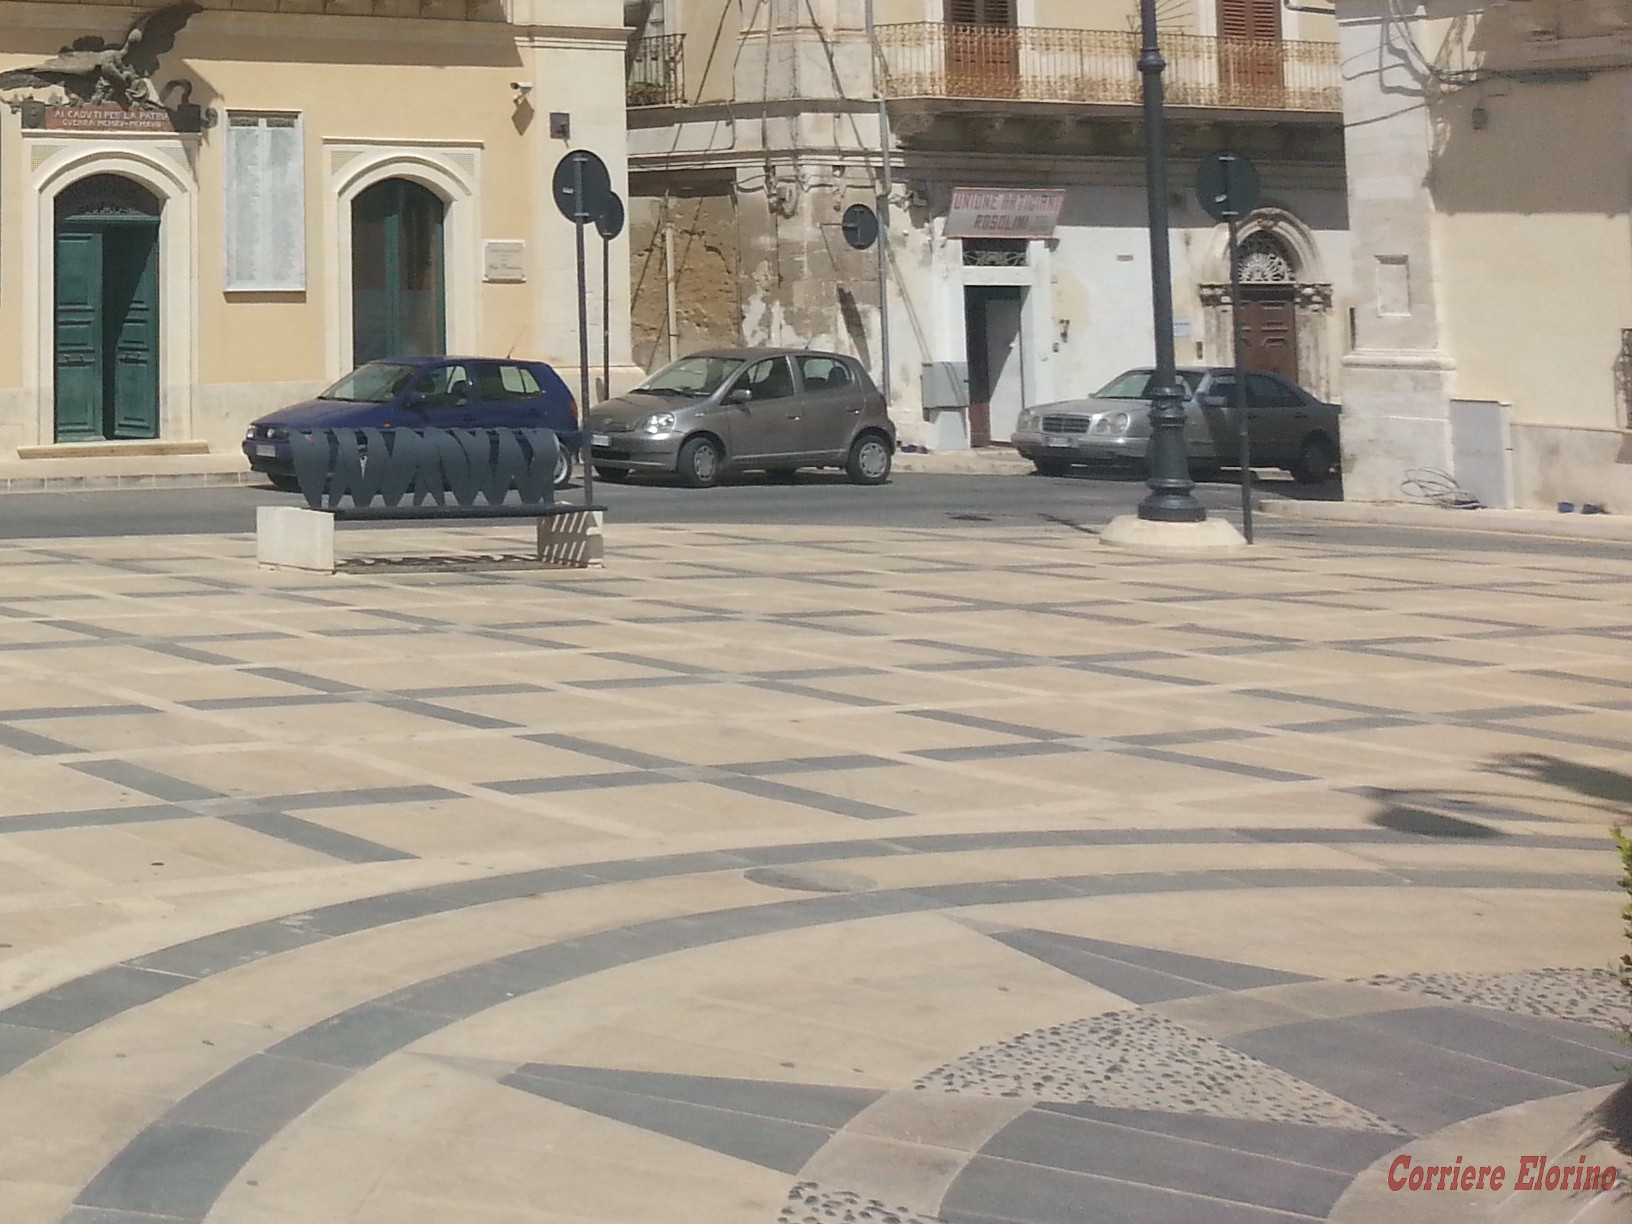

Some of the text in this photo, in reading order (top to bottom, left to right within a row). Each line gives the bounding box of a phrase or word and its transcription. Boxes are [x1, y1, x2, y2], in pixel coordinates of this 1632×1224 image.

[123, 111, 137, 120] LA
[953, 193, 997, 210] UNIONE
[973, 215, 1029, 230] ROSOLINI
